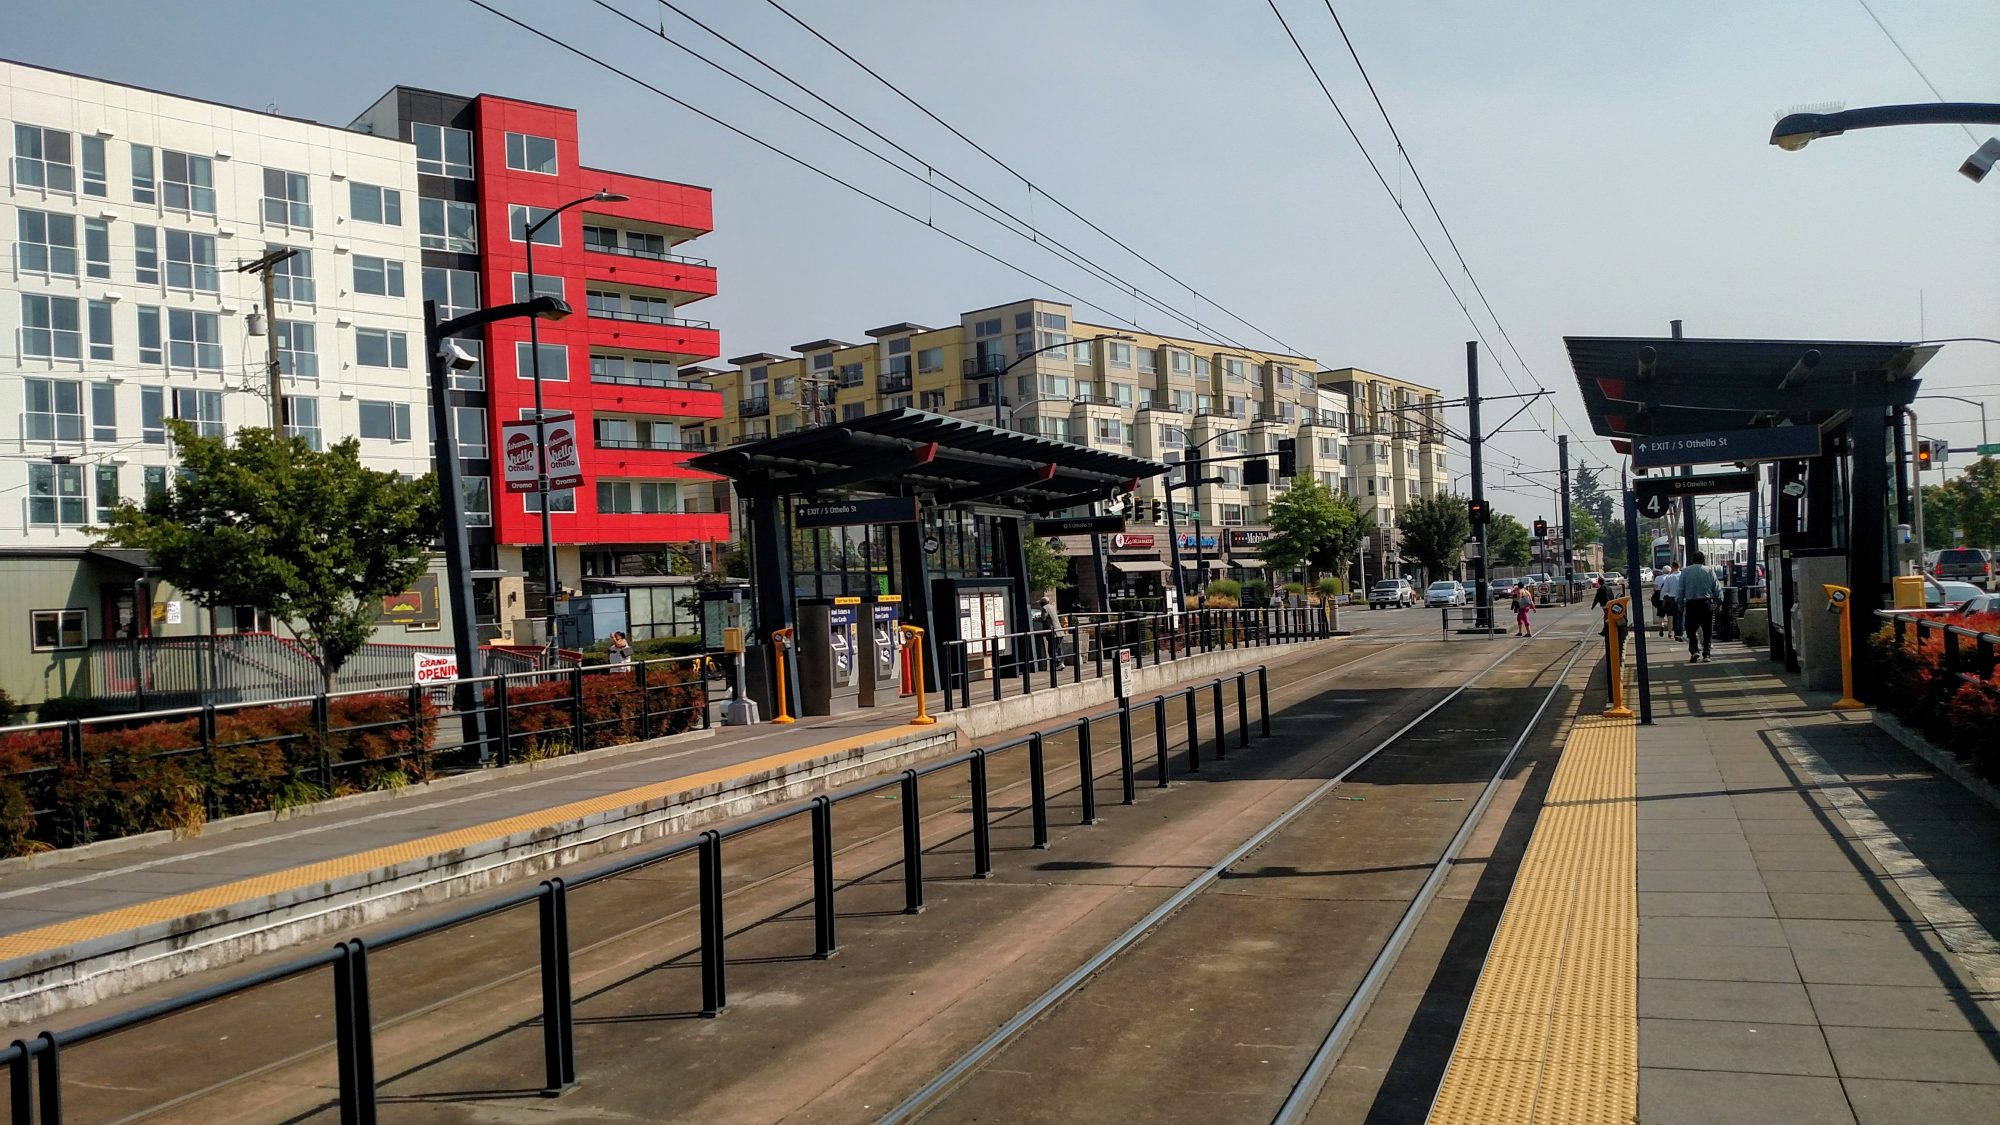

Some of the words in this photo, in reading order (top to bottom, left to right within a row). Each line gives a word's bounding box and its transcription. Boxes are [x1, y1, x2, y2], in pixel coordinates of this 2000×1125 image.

[1651, 442, 1669, 451] EXIT
[1678, 440, 1684, 449] S
[1686, 438, 1716, 448] Othello
[1719, 438, 1728, 446] St
[510, 449, 533, 465] hello
[552, 444, 572, 461] hello
[508, 464, 534, 472] Othello
[550, 460, 576, 468] Othello
[1647, 495, 1660, 513] 4
[420, 658, 448, 668] GRAND
